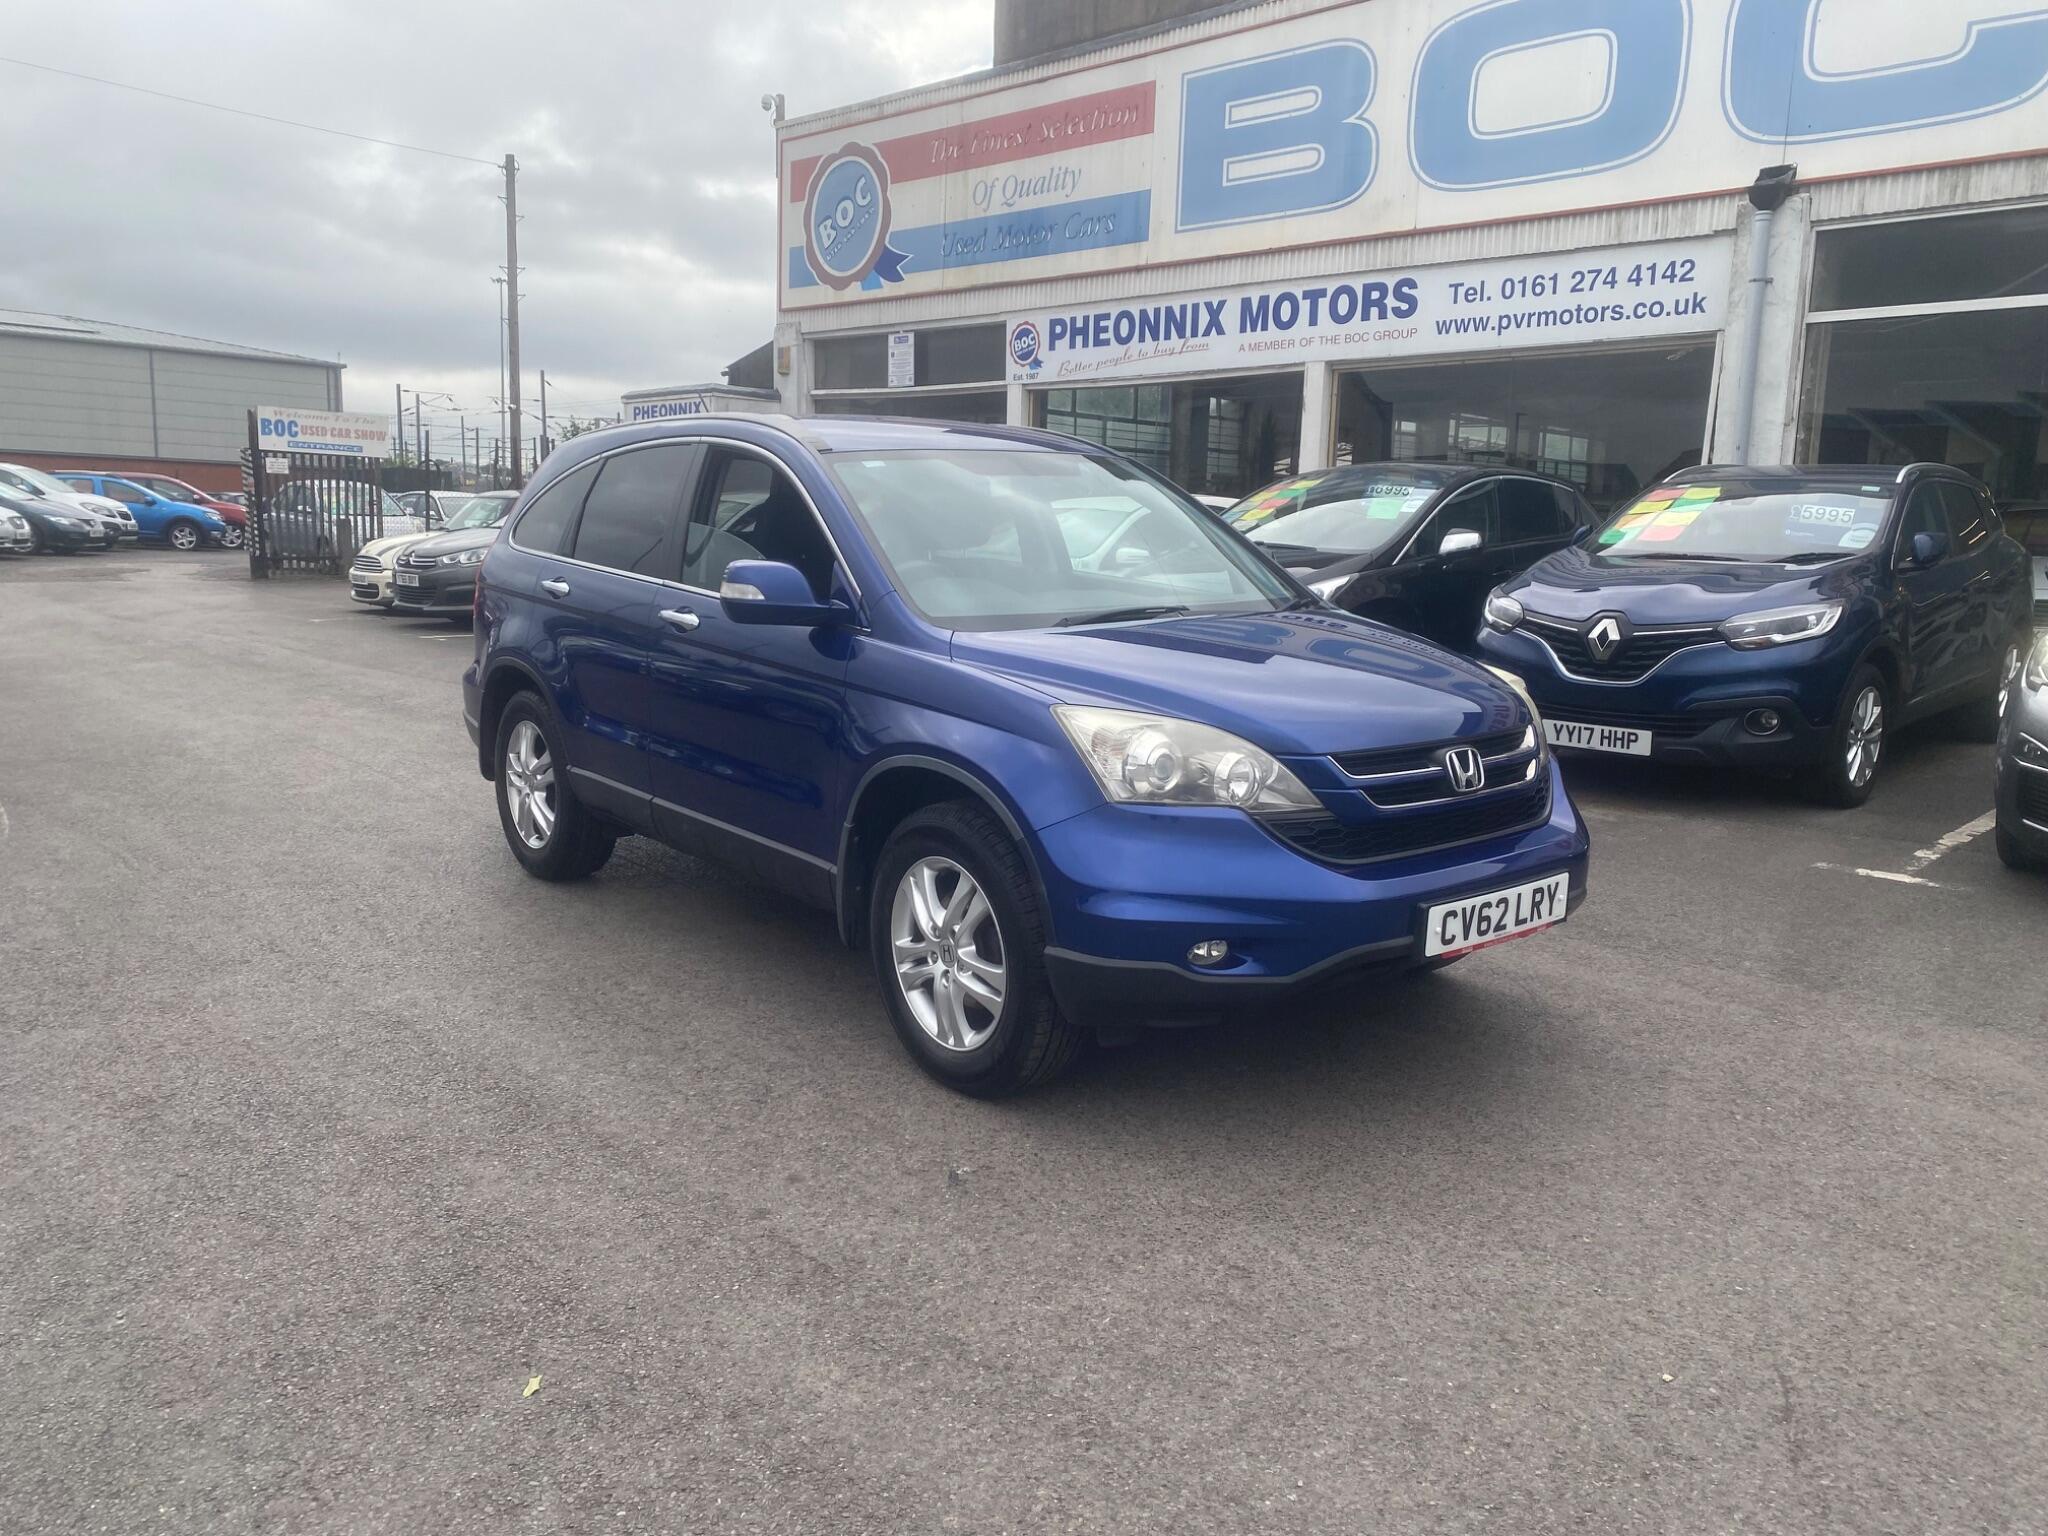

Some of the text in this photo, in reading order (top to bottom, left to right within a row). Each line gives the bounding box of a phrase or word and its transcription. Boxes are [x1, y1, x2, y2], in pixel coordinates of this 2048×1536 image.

[930, 101, 1139, 163] The Finest Selection
[973, 165, 1082, 213] Of Quality
[818, 174, 873, 249] BOC
[940, 211, 1117, 257] Used Motor Cars
[1448, 258, 1696, 304] Tel. 0161 274 4142
[1048, 277, 1418, 351] PHEONNIX MOTORS
[1435, 292, 1707, 336] www.pvrmotors.co.uk
[1014, 333, 1036, 352] BOC
[1057, 336, 1209, 377] Better people to buy from
[1238, 327, 1418, 352] A MEMBER OF THE BOC GROUP
[260, 417, 386, 442] BOC USED CAR SHOW
[633, 400, 702, 421] PHEONNIX
[289, 441, 362, 453] ENTRANCE
[1553, 723, 1639, 750] YY17 HHP
[1440, 895, 1510, 946] CV62
[1514, 881, 1559, 926] LRY
